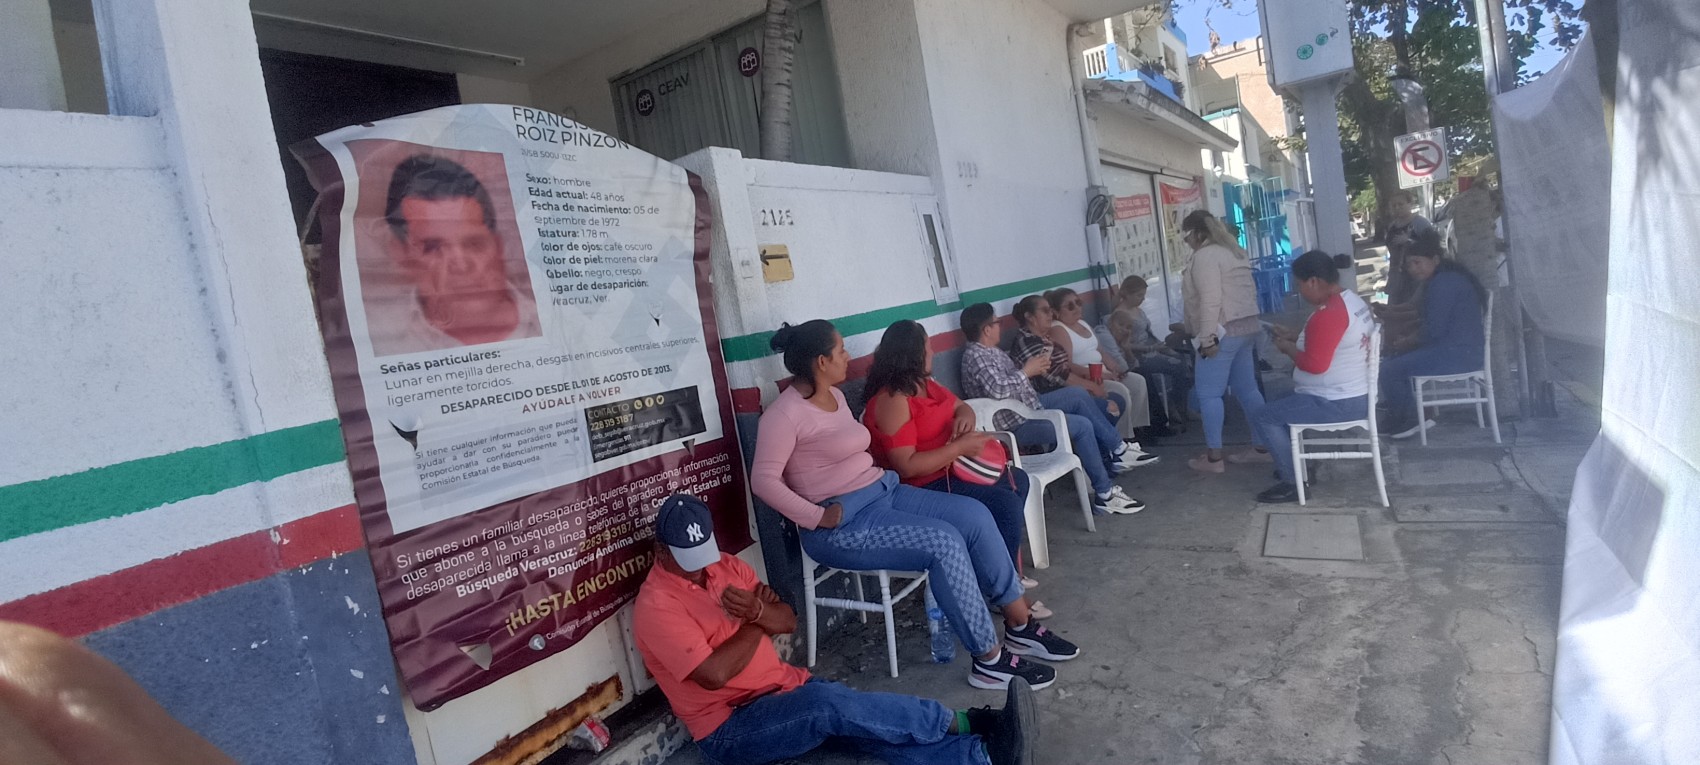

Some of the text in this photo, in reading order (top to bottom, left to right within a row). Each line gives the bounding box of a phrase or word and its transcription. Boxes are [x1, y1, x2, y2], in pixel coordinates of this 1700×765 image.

[658, 73, 690, 96] CEAV
[513, 107, 588, 130] FRANCI
[516, 124, 558, 144] ROIZ
[553, 175, 591, 187] hombre
[528, 186, 625, 202] Edad actual: 48 años
[531, 200, 660, 215] Fecha de nacimiento: 05 de
[588, 217, 600, 226] de
[601, 218, 620, 227] 1972
[566, 242, 579, 251] de
[581, 242, 603, 253] ojos:
[624, 243, 653, 251] oscuro
[568, 255, 582, 265] de
[583, 254, 604, 266] piel:
[604, 256, 637, 264] morena
[638, 255, 658, 263] clara
[576, 281, 589, 291] de
[590, 280, 649, 291] desaparición:
[584, 268, 614, 279] negro,
[614, 268, 642, 278] crespo
[380, 350, 502, 375] Señas particulares:
[385, 377, 423, 390] Lunar
[426, 374, 443, 384] en
[445, 366, 483, 381] mejilla
[485, 360, 534, 374] derecha,
[574, 353, 585, 361] en
[586, 347, 624, 360] incisivos
[624, 341, 661, 354] centrales
[387, 376, 515, 407] ligeramente torcidos.
[440, 389, 533, 415] DESAPARECIDO
[535, 382, 571, 396] DESDE
[572, 380, 582, 390] EL
[590, 377, 601, 386] DE
[602, 371, 640, 384] AGOSTO
[641, 367, 653, 378] DE
[578, 393, 585, 402] A
[586, 386, 621, 400] VOLVER
[416, 457, 446, 470] ayudar
[463, 449, 477, 459] dar
[482, 445, 497, 454] con
[502, 442, 512, 450] su
[517, 433, 552, 447] paradero
[426, 447, 448, 458] tiene
[451, 438, 488, 451] cualquier
[489, 426, 537, 443] información
[538, 423, 553, 432] que
[419, 460, 479, 481] proporcionarla
[486, 441, 557, 463] confidencialmente
[421, 473, 461, 490] Comisión
[462, 467, 489, 480] Estatal
[490, 463, 501, 473] de
[396, 453, 729, 569] Si tienes un familiar desaparecdo, quieres proporcionar información
[401, 568, 428, 588] que
[434, 550, 475, 573] abone
[481, 546, 490, 556] a
[494, 540, 507, 552] la
[510, 521, 569, 546] búsqueda
[574, 516, 583, 526] o
[612, 497, 624, 511] del
[626, 485, 664, 507] paradero
[666, 478, 678, 491] de
[682, 475, 698, 487] una
[700, 463, 731, 481] persona
[406, 560, 492, 600] desaparecida
[496, 548, 529, 566] llama
[533, 544, 540, 554] a
[544, 539, 556, 551] la
[588, 512, 626, 535] telefónica
[628, 506, 640, 517] de
[641, 502, 650, 513] la
[693, 477, 721, 495] Estatal
[721, 473, 732, 485] de
[547, 553, 595, 579] Denuncia
[595, 536, 634, 559] Anónima
[455, 566, 519, 598] Búsqueda
[519, 546, 578, 573] Veracruz:
